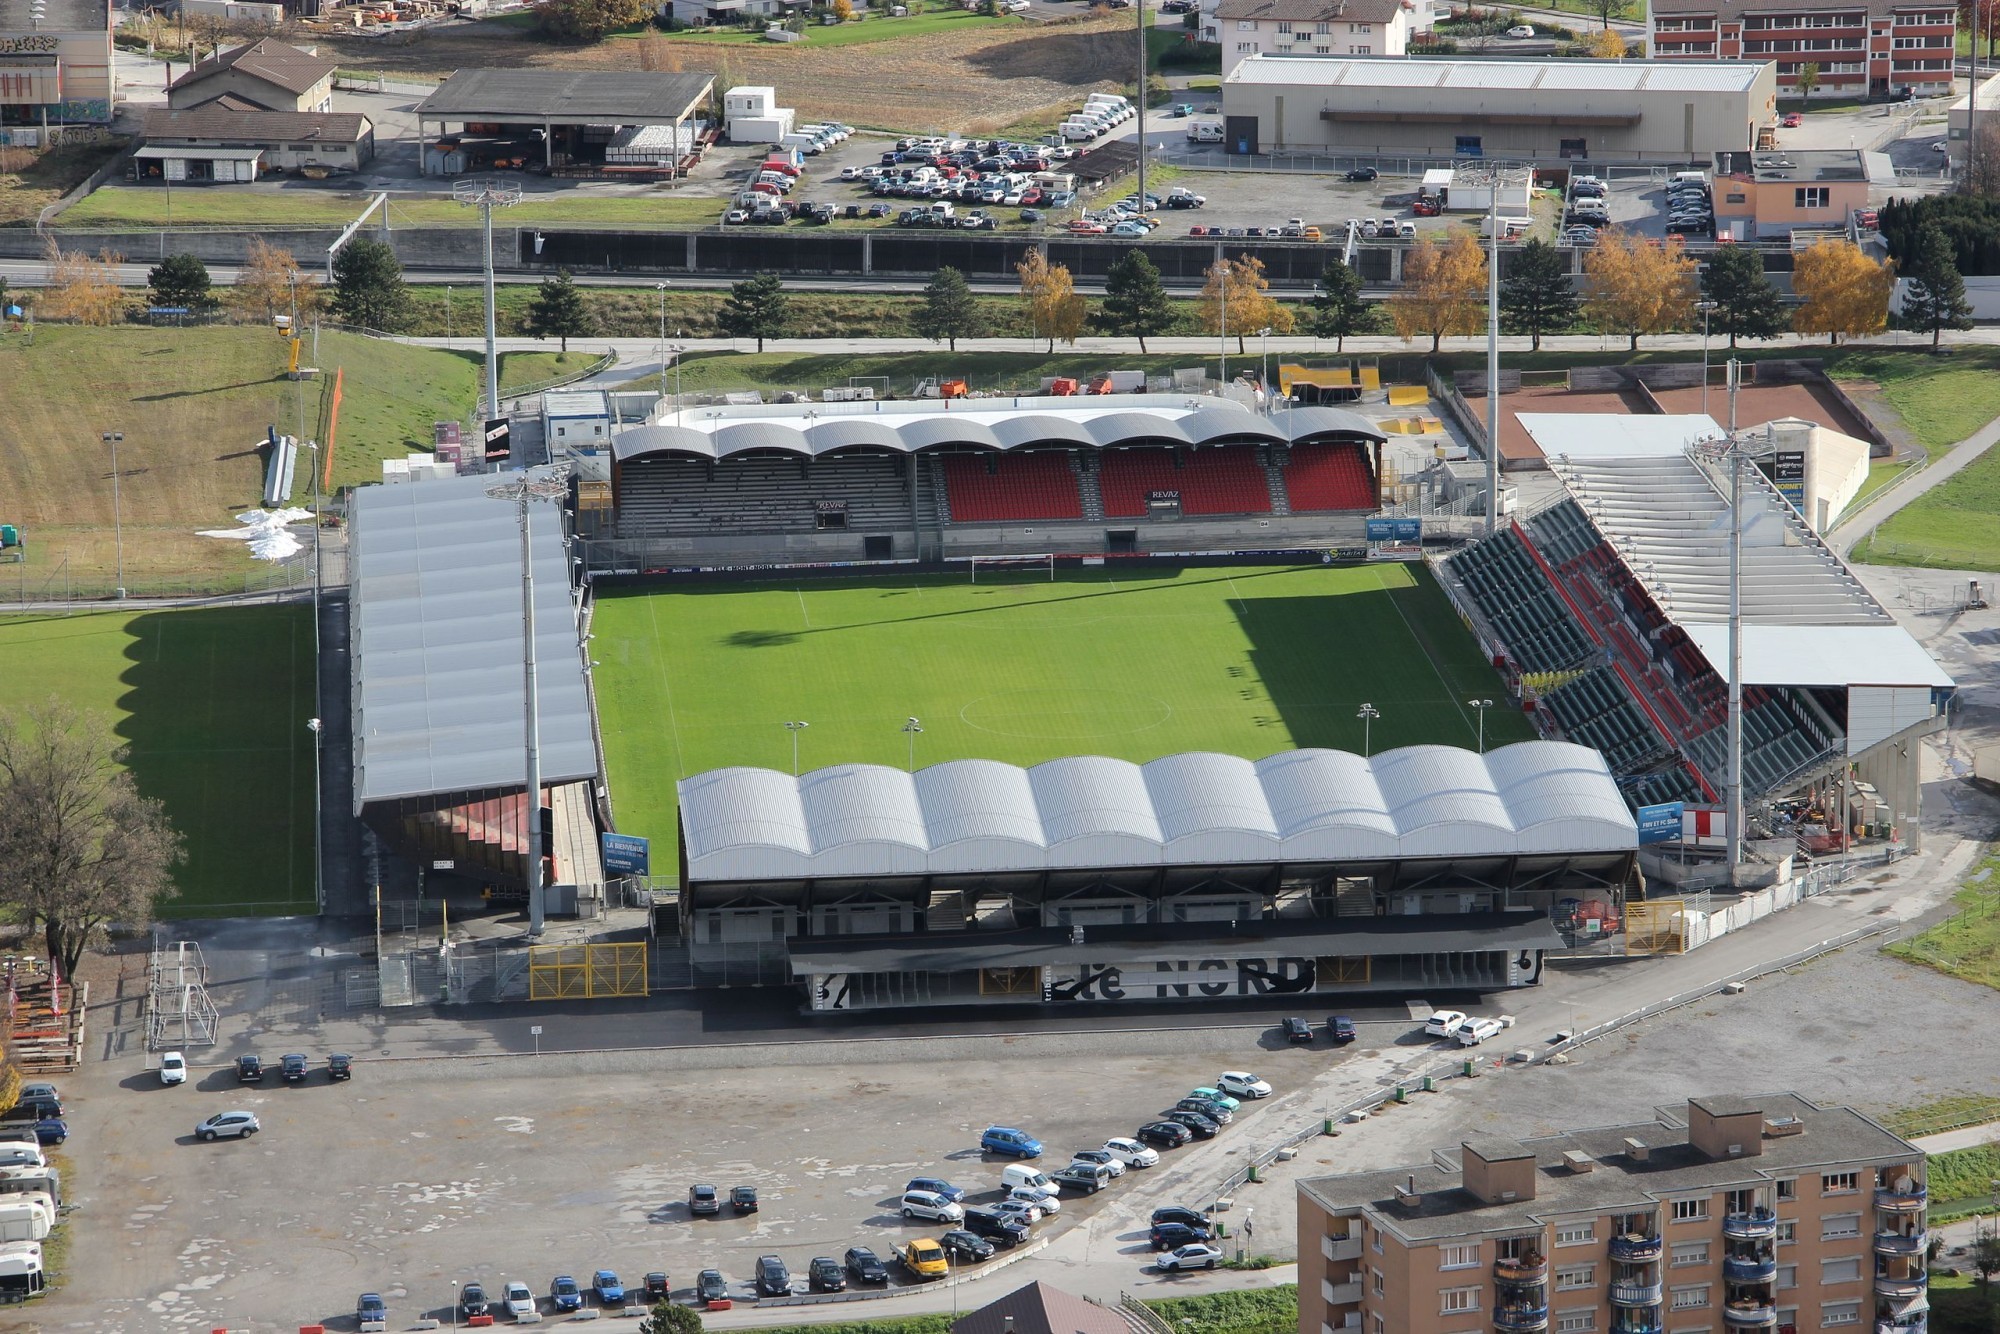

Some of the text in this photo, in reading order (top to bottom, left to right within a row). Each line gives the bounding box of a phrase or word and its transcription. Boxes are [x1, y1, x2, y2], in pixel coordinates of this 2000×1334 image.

[1152, 490, 1179, 498] REVAZ
[820, 501, 846, 509] REVAZ
[614, 843, 643, 853] BIENVENUE
[1044, 965, 1052, 1002] tribune
[1156, 957, 1308, 998] NORD
[815, 977, 824, 1010] billets
